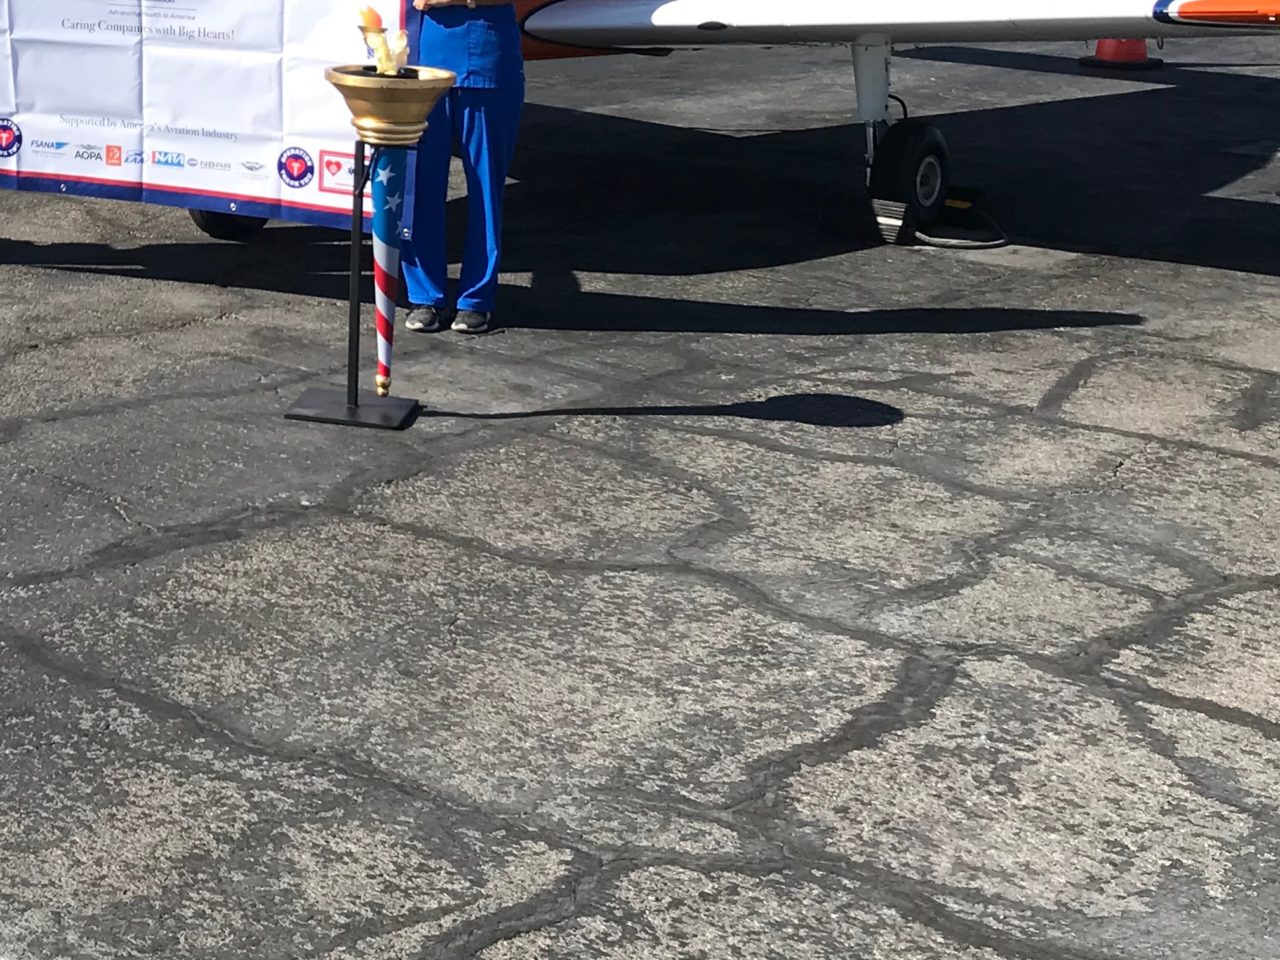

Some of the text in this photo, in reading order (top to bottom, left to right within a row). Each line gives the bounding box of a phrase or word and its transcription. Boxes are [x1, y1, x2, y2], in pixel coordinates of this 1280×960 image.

[61, 18, 235, 40] Caring Companies with Big Hearts!
[59, 114, 105, 128] Supported
[107, 117, 117, 128] by
[164, 123, 200, 137] Aviation
[201, 127, 238, 143] Industry
[31, 140, 55, 148] FSANA
[74, 150, 103, 161] AOPA
